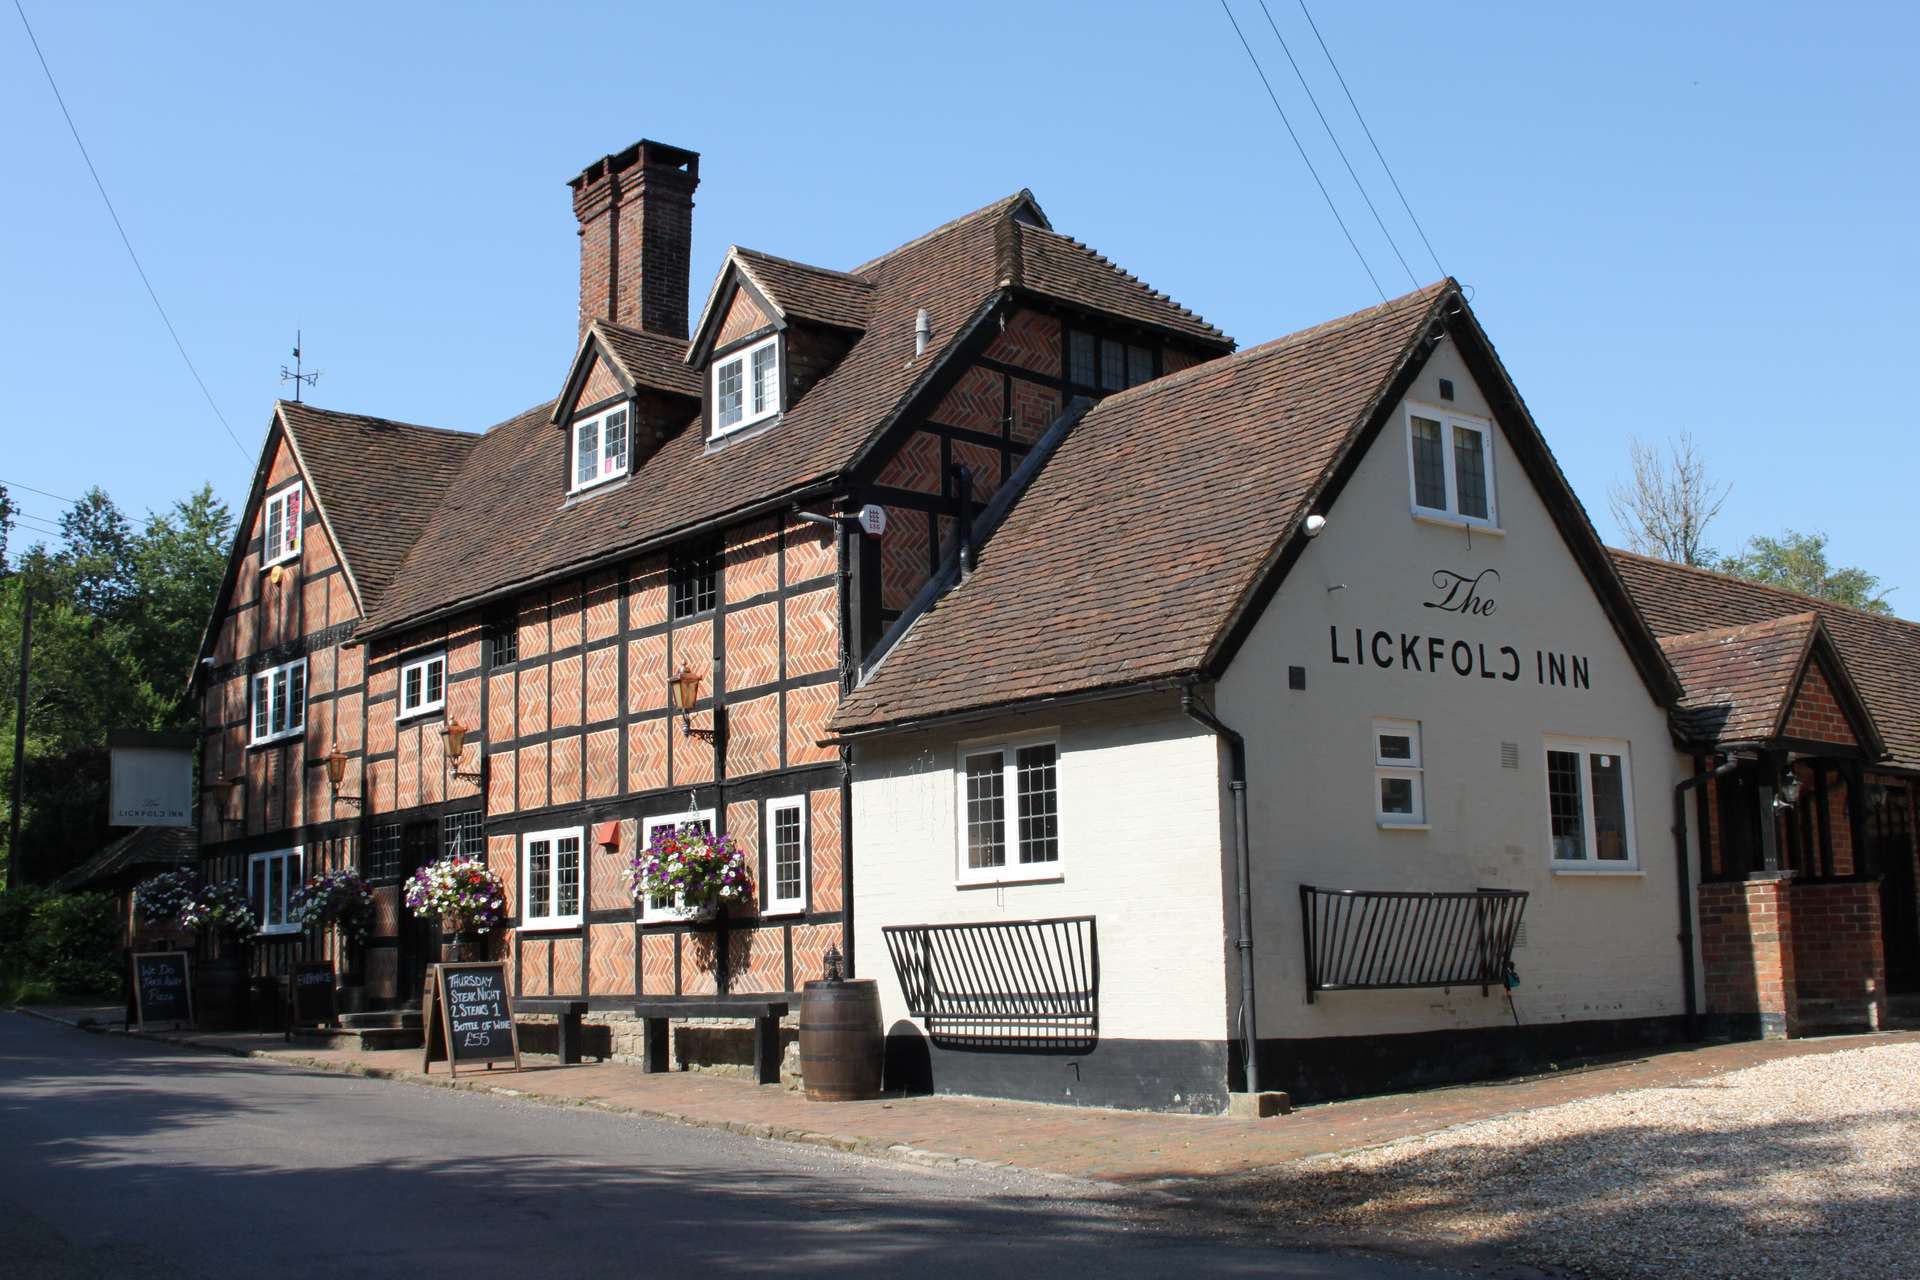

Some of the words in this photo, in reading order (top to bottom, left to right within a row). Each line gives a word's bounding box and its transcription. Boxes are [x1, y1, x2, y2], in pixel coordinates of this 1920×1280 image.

[1423, 568, 1501, 616] The
[1537, 650, 1590, 689] INN
[447, 974, 493, 988] THURSDAY
[451, 989, 476, 1003] STEAK
[477, 986, 501, 1000] NIGHT
[451, 1005, 459, 1017] 2
[492, 1002, 501, 1016] 1
[453, 1020, 479, 1032] BOTTLE
[481, 1021, 492, 1030] OF
[493, 1020, 512, 1029] WINE
[464, 1032, 490, 1046] £55
